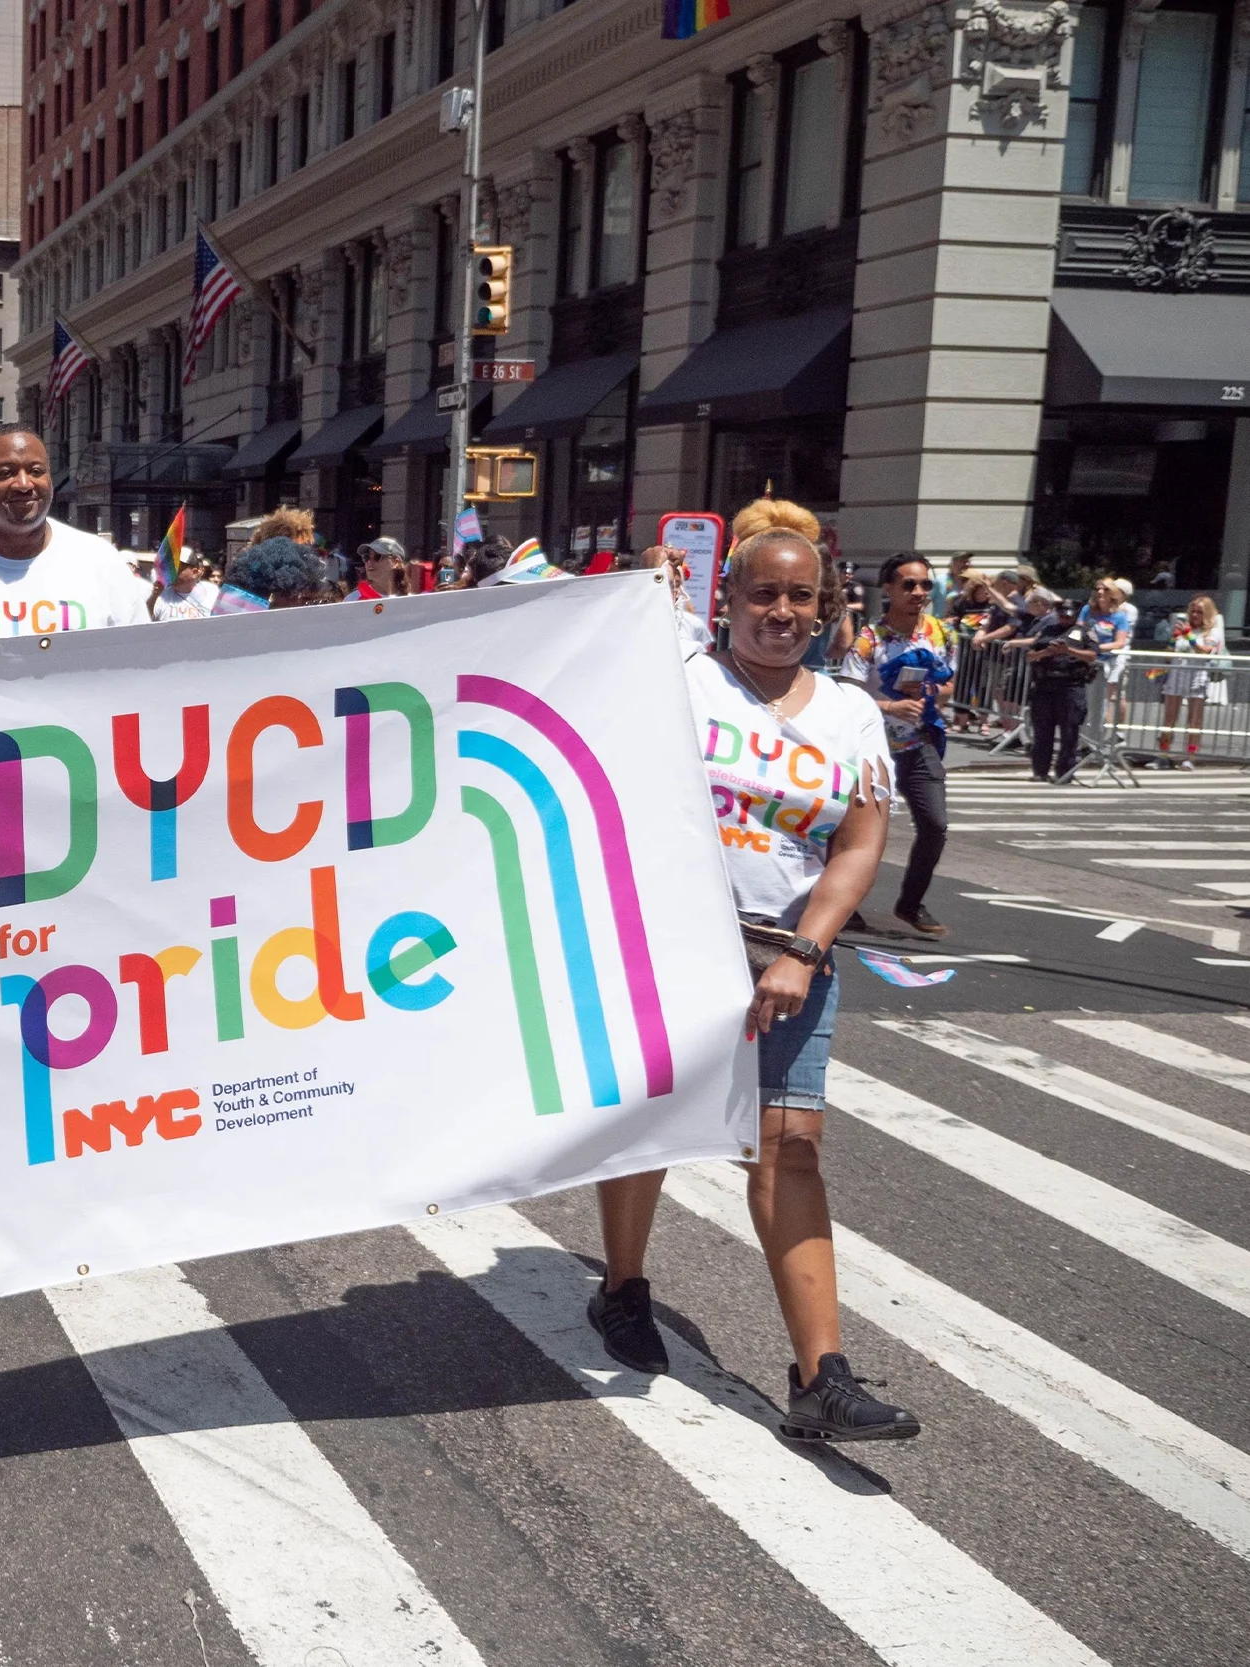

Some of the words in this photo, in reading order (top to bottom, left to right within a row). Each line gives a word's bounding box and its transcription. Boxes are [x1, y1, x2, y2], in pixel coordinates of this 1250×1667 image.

[482, 366, 488, 378] E
[492, 365, 504, 379] 26
[509, 365, 520, 379] St
[1221, 386, 1245, 400] 225
[704, 718, 858, 804] DYCD
[707, 768, 772, 794] elebrates
[719, 824, 771, 853] NYC
[0, 865, 458, 1166] pride
[212, 1071, 299, 1096] Department
[303, 1068, 318, 1082] of
[213, 1097, 255, 1113] Youth
[259, 1093, 269, 1107] &
[273, 1081, 355, 1104] Community
[63, 1088, 202, 1158] NYC
[215, 1105, 313, 1131] Development
